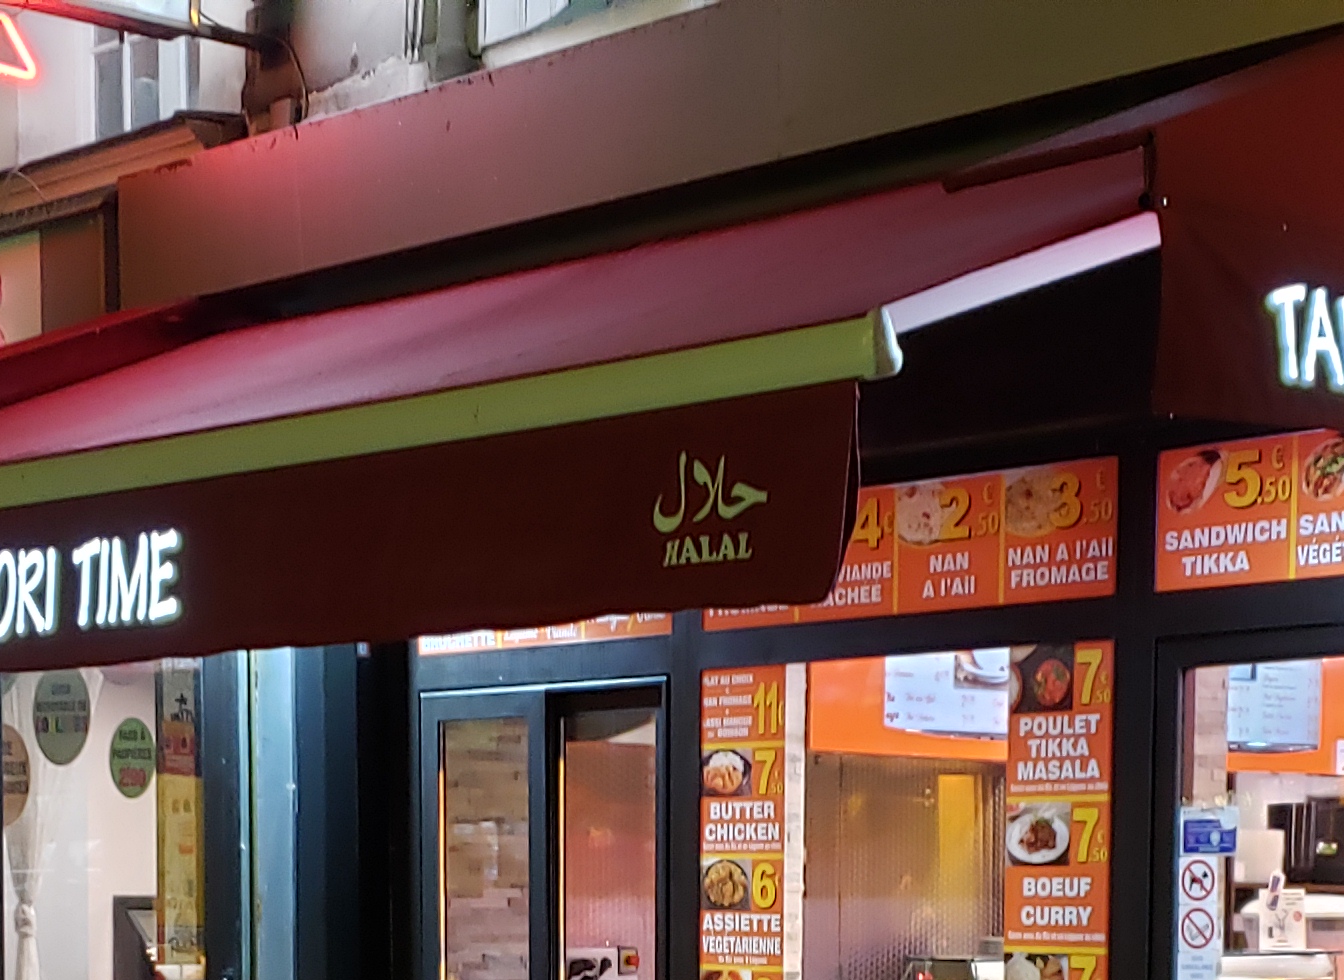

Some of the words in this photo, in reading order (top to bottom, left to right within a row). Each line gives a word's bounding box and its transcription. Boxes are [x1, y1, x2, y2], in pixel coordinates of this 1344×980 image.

[653, 450, 768, 533] حلال
[1165, 518, 1288, 551] SANDWICH
[663, 532, 753, 567] HALAL
[1008, 543, 1049, 567] NAN
[1056, 541, 1068, 561] A
[929, 552, 970, 573] NAN
[1182, 551, 1250, 577] TIKKA
[71, 527, 180, 628] TIME
[1010, 561, 1109, 590] FROMAGE
[922, 580, 934, 599] A
[1019, 712, 1100, 737] POULET
[1027, 736, 1089, 758] TIKKA
[1017, 758, 1100, 781] MASALA
[710, 801, 775, 820] BUTTER
[704, 821, 780, 842] CHICKEN
[1022, 876, 1092, 898] BOEUF
[703, 912, 781, 932] ASSIETTE
[1020, 905, 1093, 927] CURRY
[702, 931, 781, 955] VÉGÉTARIENNE
